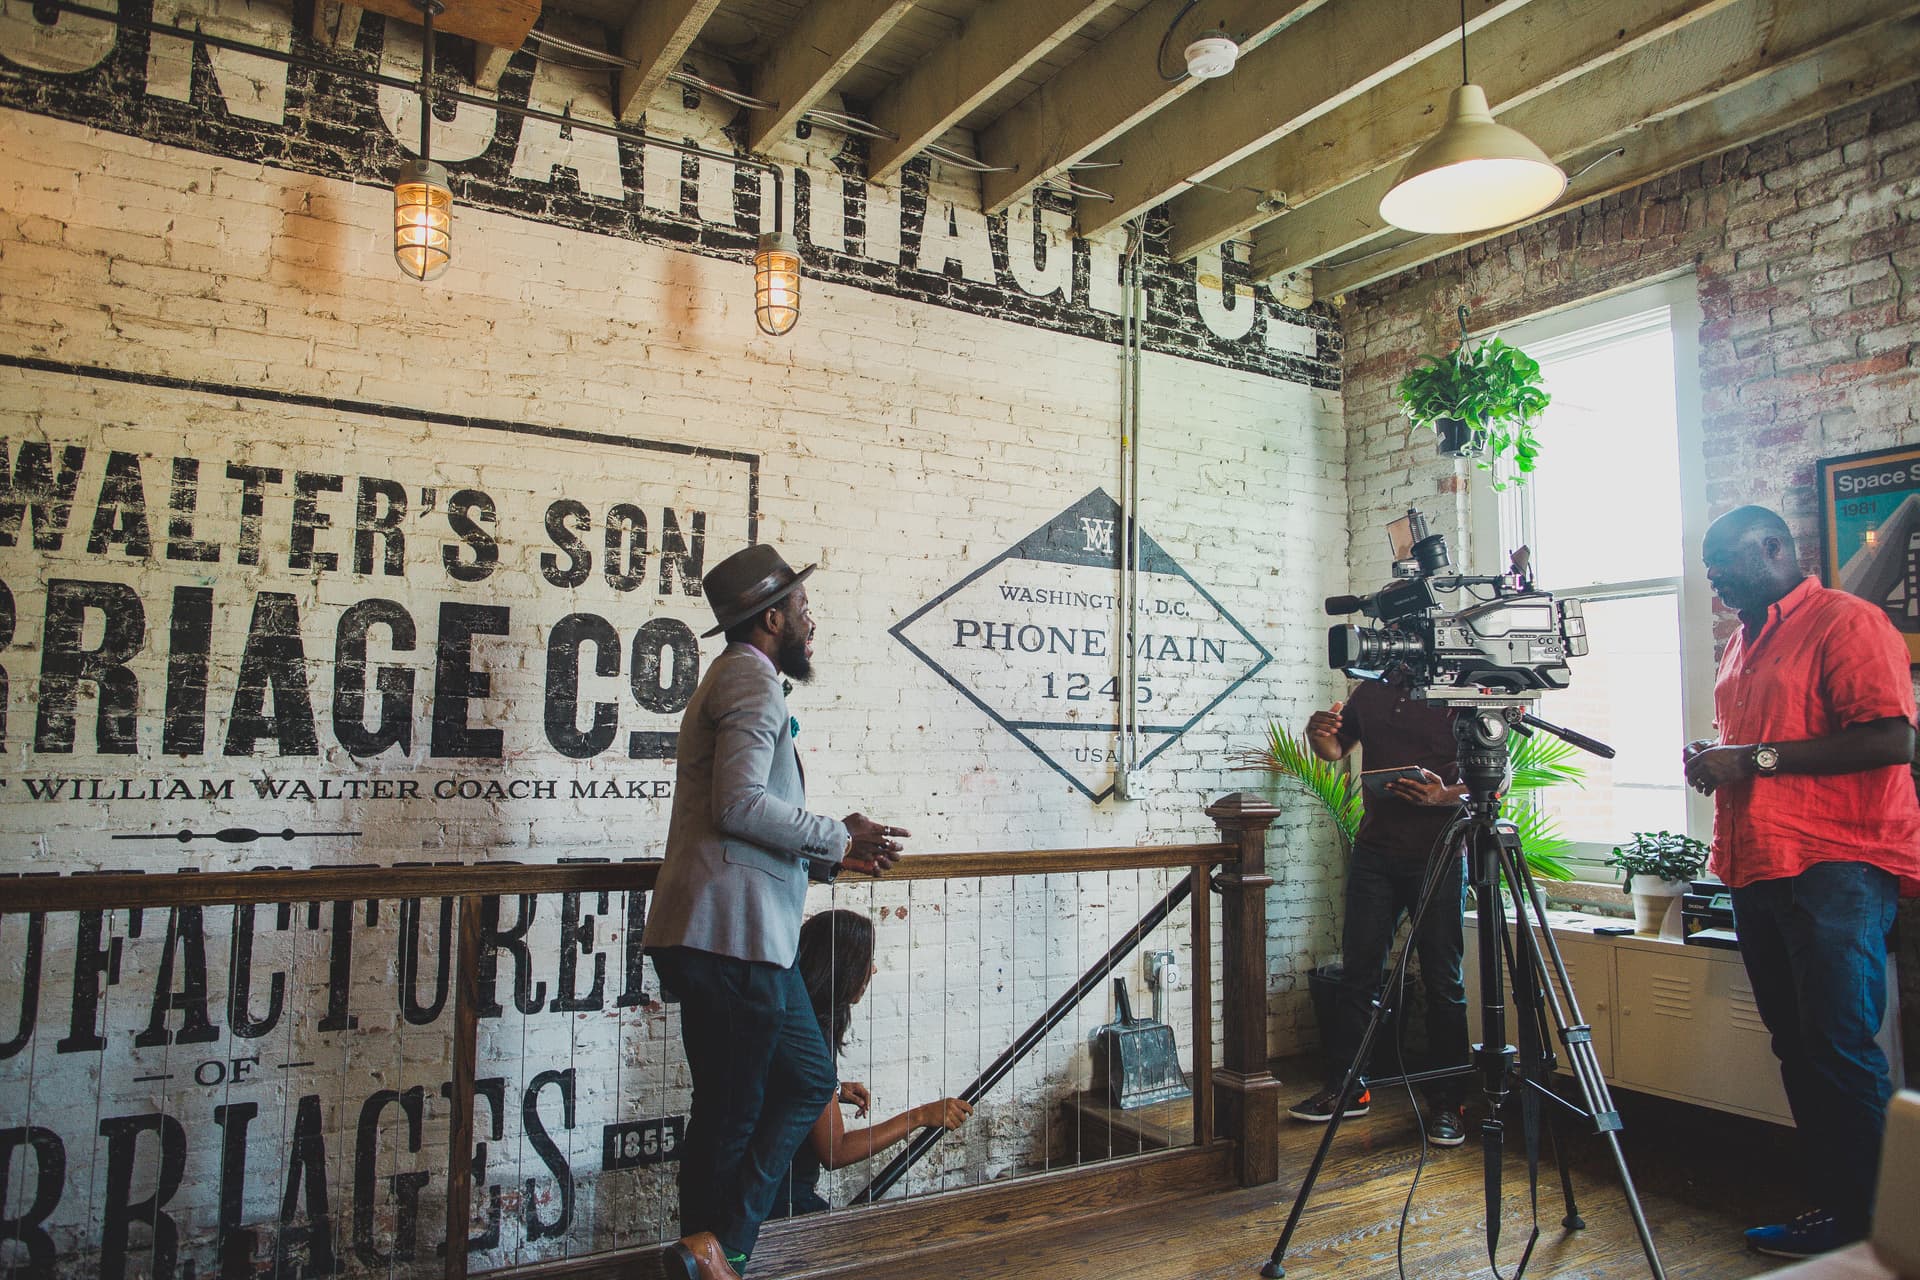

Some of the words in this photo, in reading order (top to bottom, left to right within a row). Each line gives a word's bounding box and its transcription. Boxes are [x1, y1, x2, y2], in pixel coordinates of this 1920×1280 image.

[1839, 471, 1906, 494] Space
[0, 440, 499, 582] WALTER'S
[540, 499, 706, 597] SON
[1842, 502, 1876, 517] 1981
[1155, 599, 1190, 617] D.C.
[953, 619, 1106, 658] PHONE
[0, 575, 510, 759] RIAGE
[1041, 671, 1153, 704] 1245
[1075, 747, 1119, 763] USA
[22, 778, 235, 800] WILLIAM
[252, 778, 419, 800] WALTER
[434, 779, 557, 800] COACH
[569, 780, 676, 800] MAKE
[194, 1057, 260, 1087] OF
[613, 1126, 676, 1160] 1855
